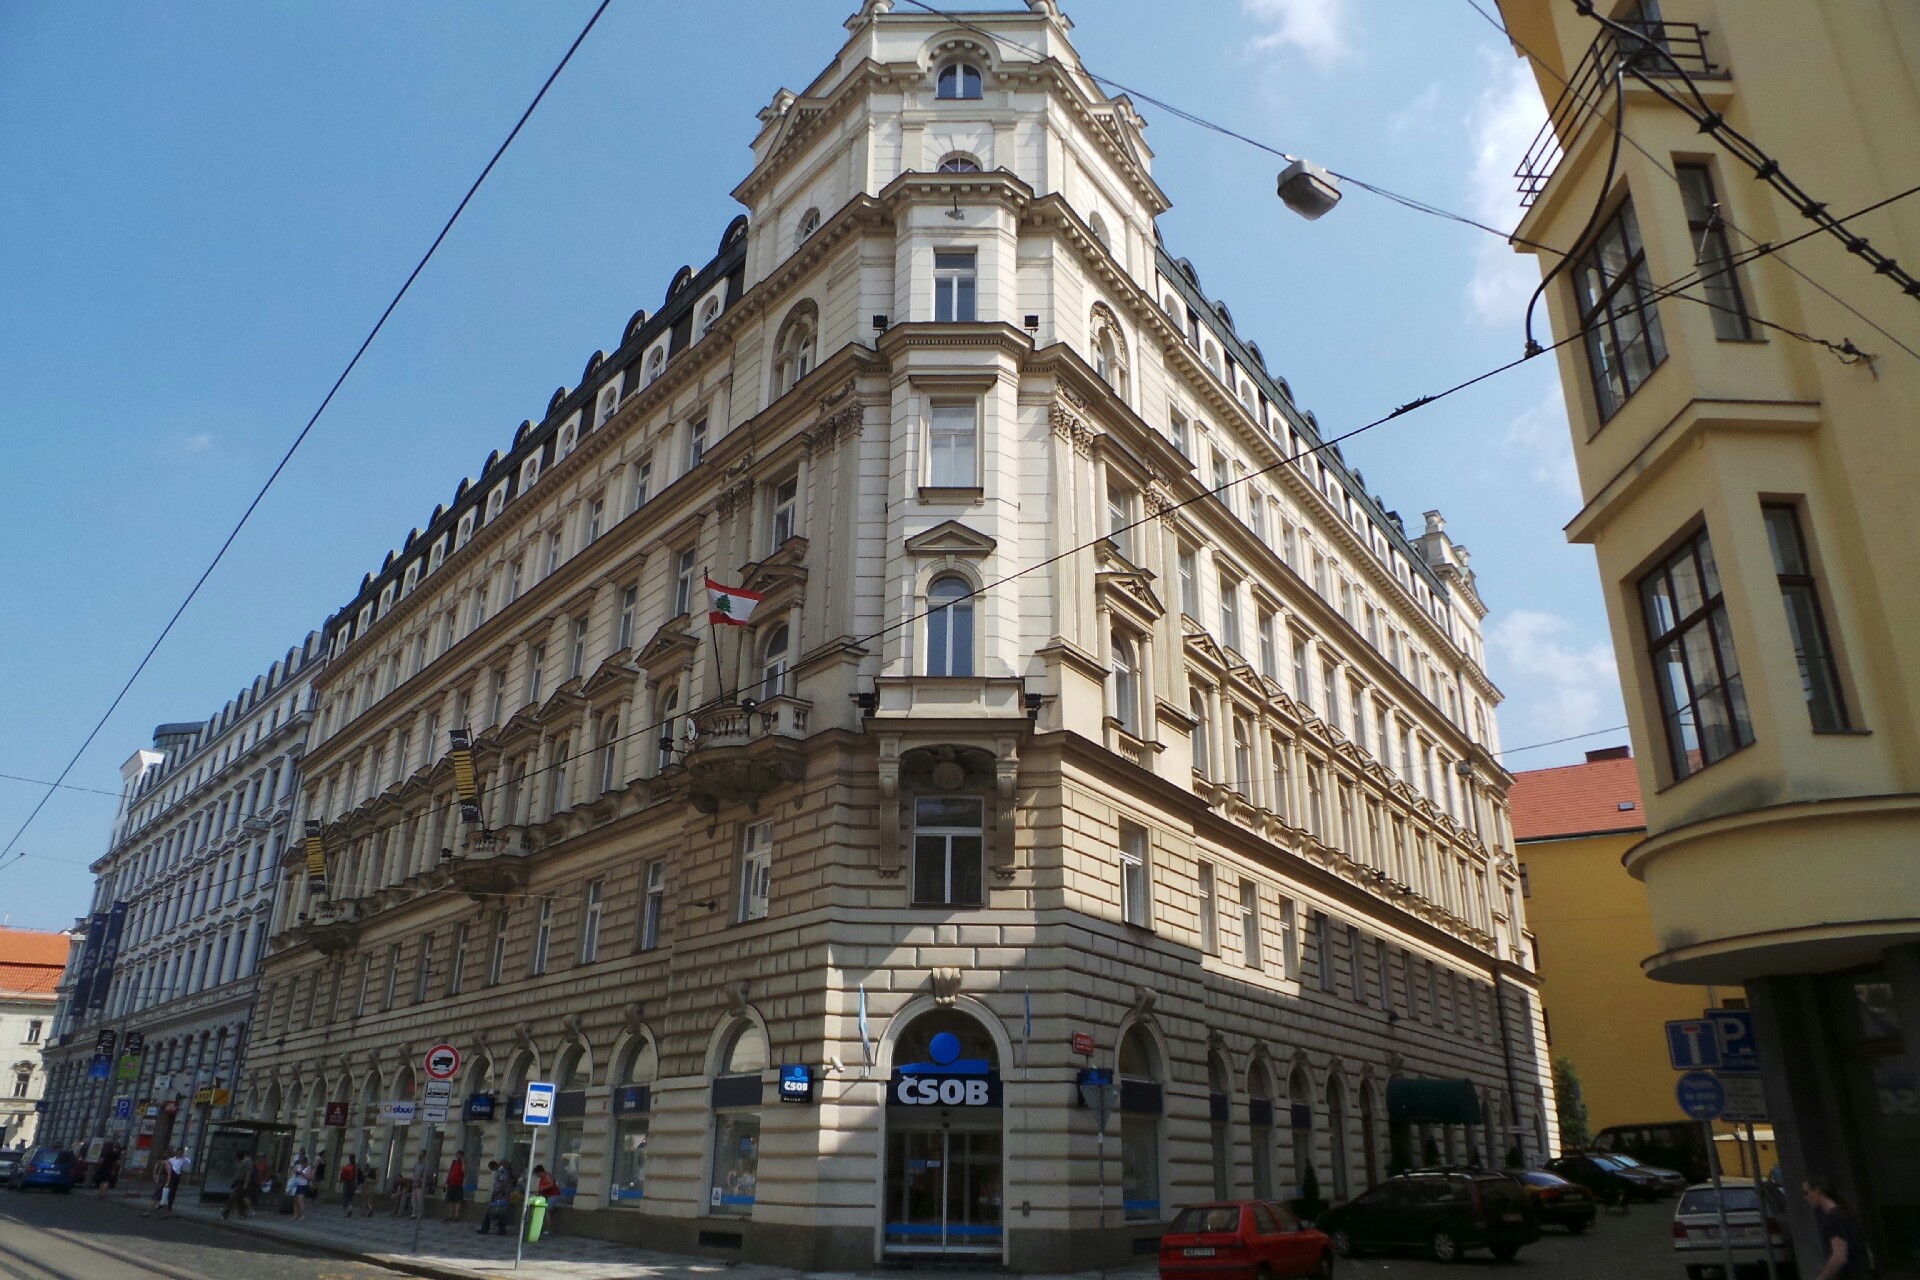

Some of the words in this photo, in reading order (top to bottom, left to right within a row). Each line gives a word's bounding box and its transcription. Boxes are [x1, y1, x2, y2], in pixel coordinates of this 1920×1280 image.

[1717, 1017, 1746, 1053] P
[784, 1081, 808, 1092] ČSOB
[897, 1075, 989, 1105] ČSOB
